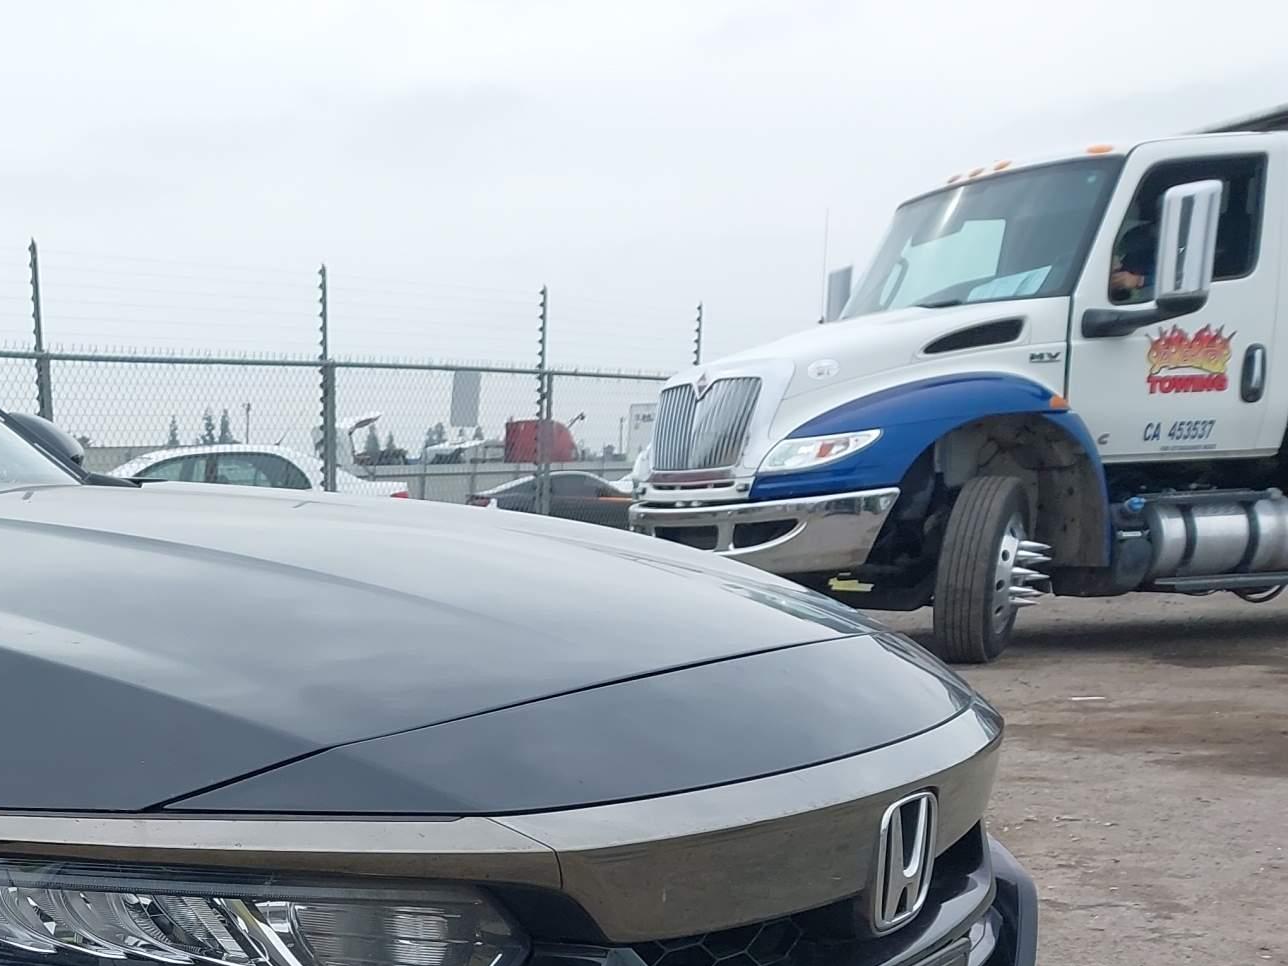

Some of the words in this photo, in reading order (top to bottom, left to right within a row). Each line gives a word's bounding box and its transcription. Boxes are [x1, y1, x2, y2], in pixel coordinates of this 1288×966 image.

[1146, 374, 1228, 394] TOWING
[1143, 421, 1161, 441] CA
[1168, 420, 1216, 440] 453537
